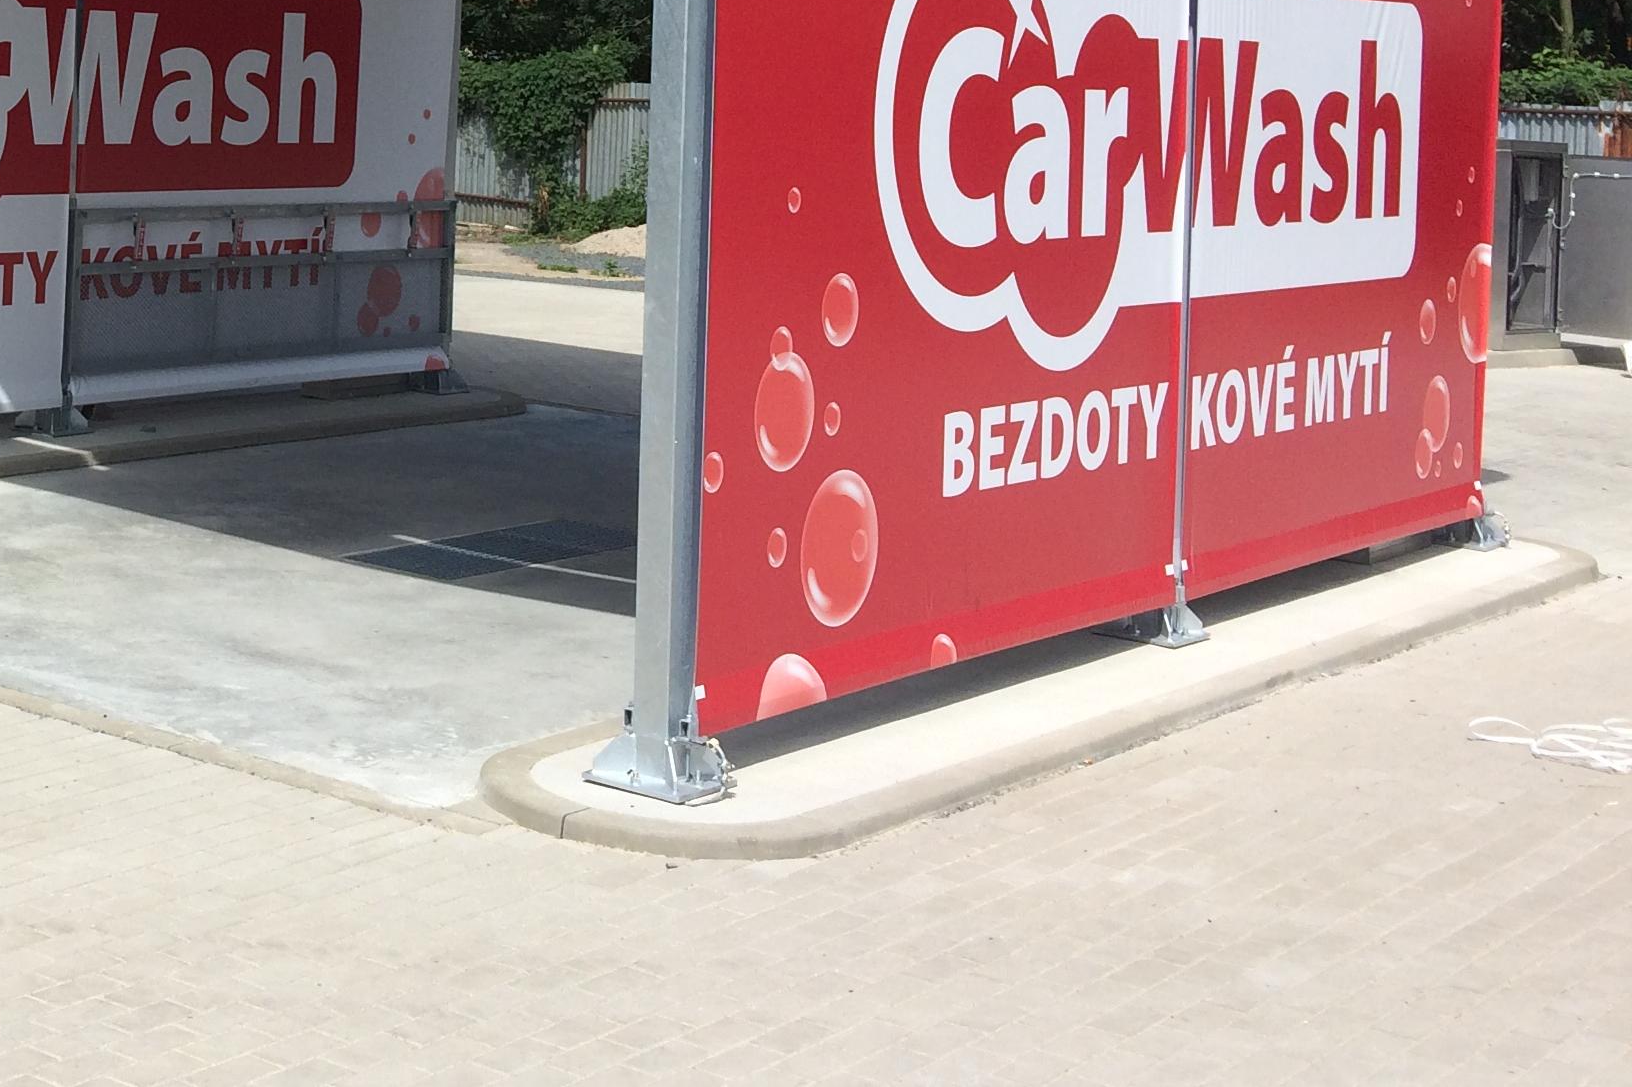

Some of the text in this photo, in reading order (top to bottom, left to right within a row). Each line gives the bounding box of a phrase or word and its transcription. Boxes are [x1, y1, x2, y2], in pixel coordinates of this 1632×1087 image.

[918, 26, 1403, 247] CarWash
[216, 226, 323, 292] MYTÍ
[1305, 330, 1392, 429] MYTÍ
